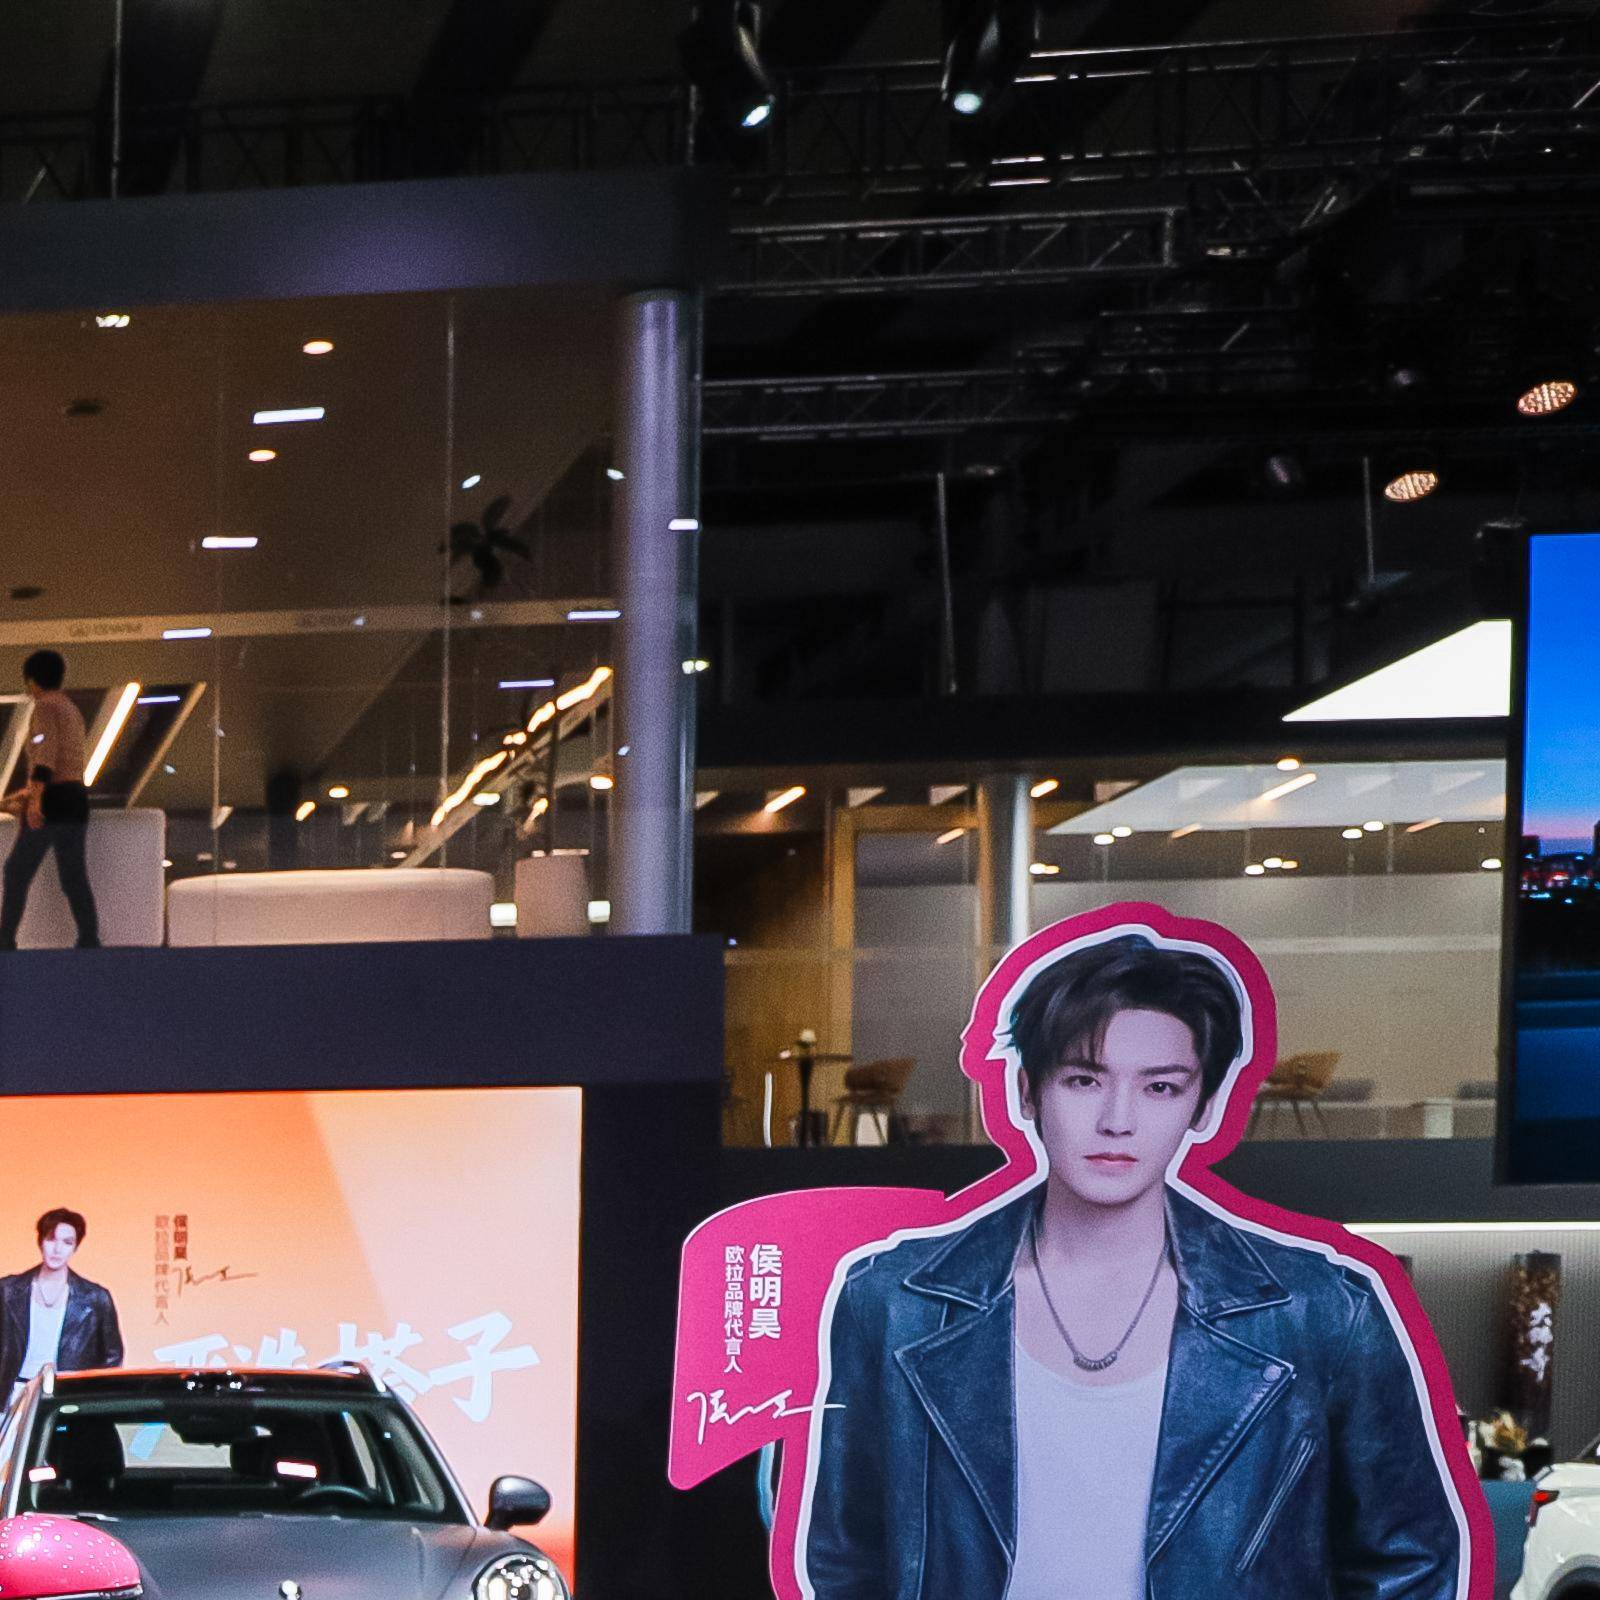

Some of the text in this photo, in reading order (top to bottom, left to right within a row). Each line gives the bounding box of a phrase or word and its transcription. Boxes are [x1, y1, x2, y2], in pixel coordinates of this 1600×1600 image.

[724, 1246, 744, 1374] 欧拉品牌代言人
[748, 1243, 783, 1339] 侯明昊
[153, 1311, 541, 1422] 搭子
